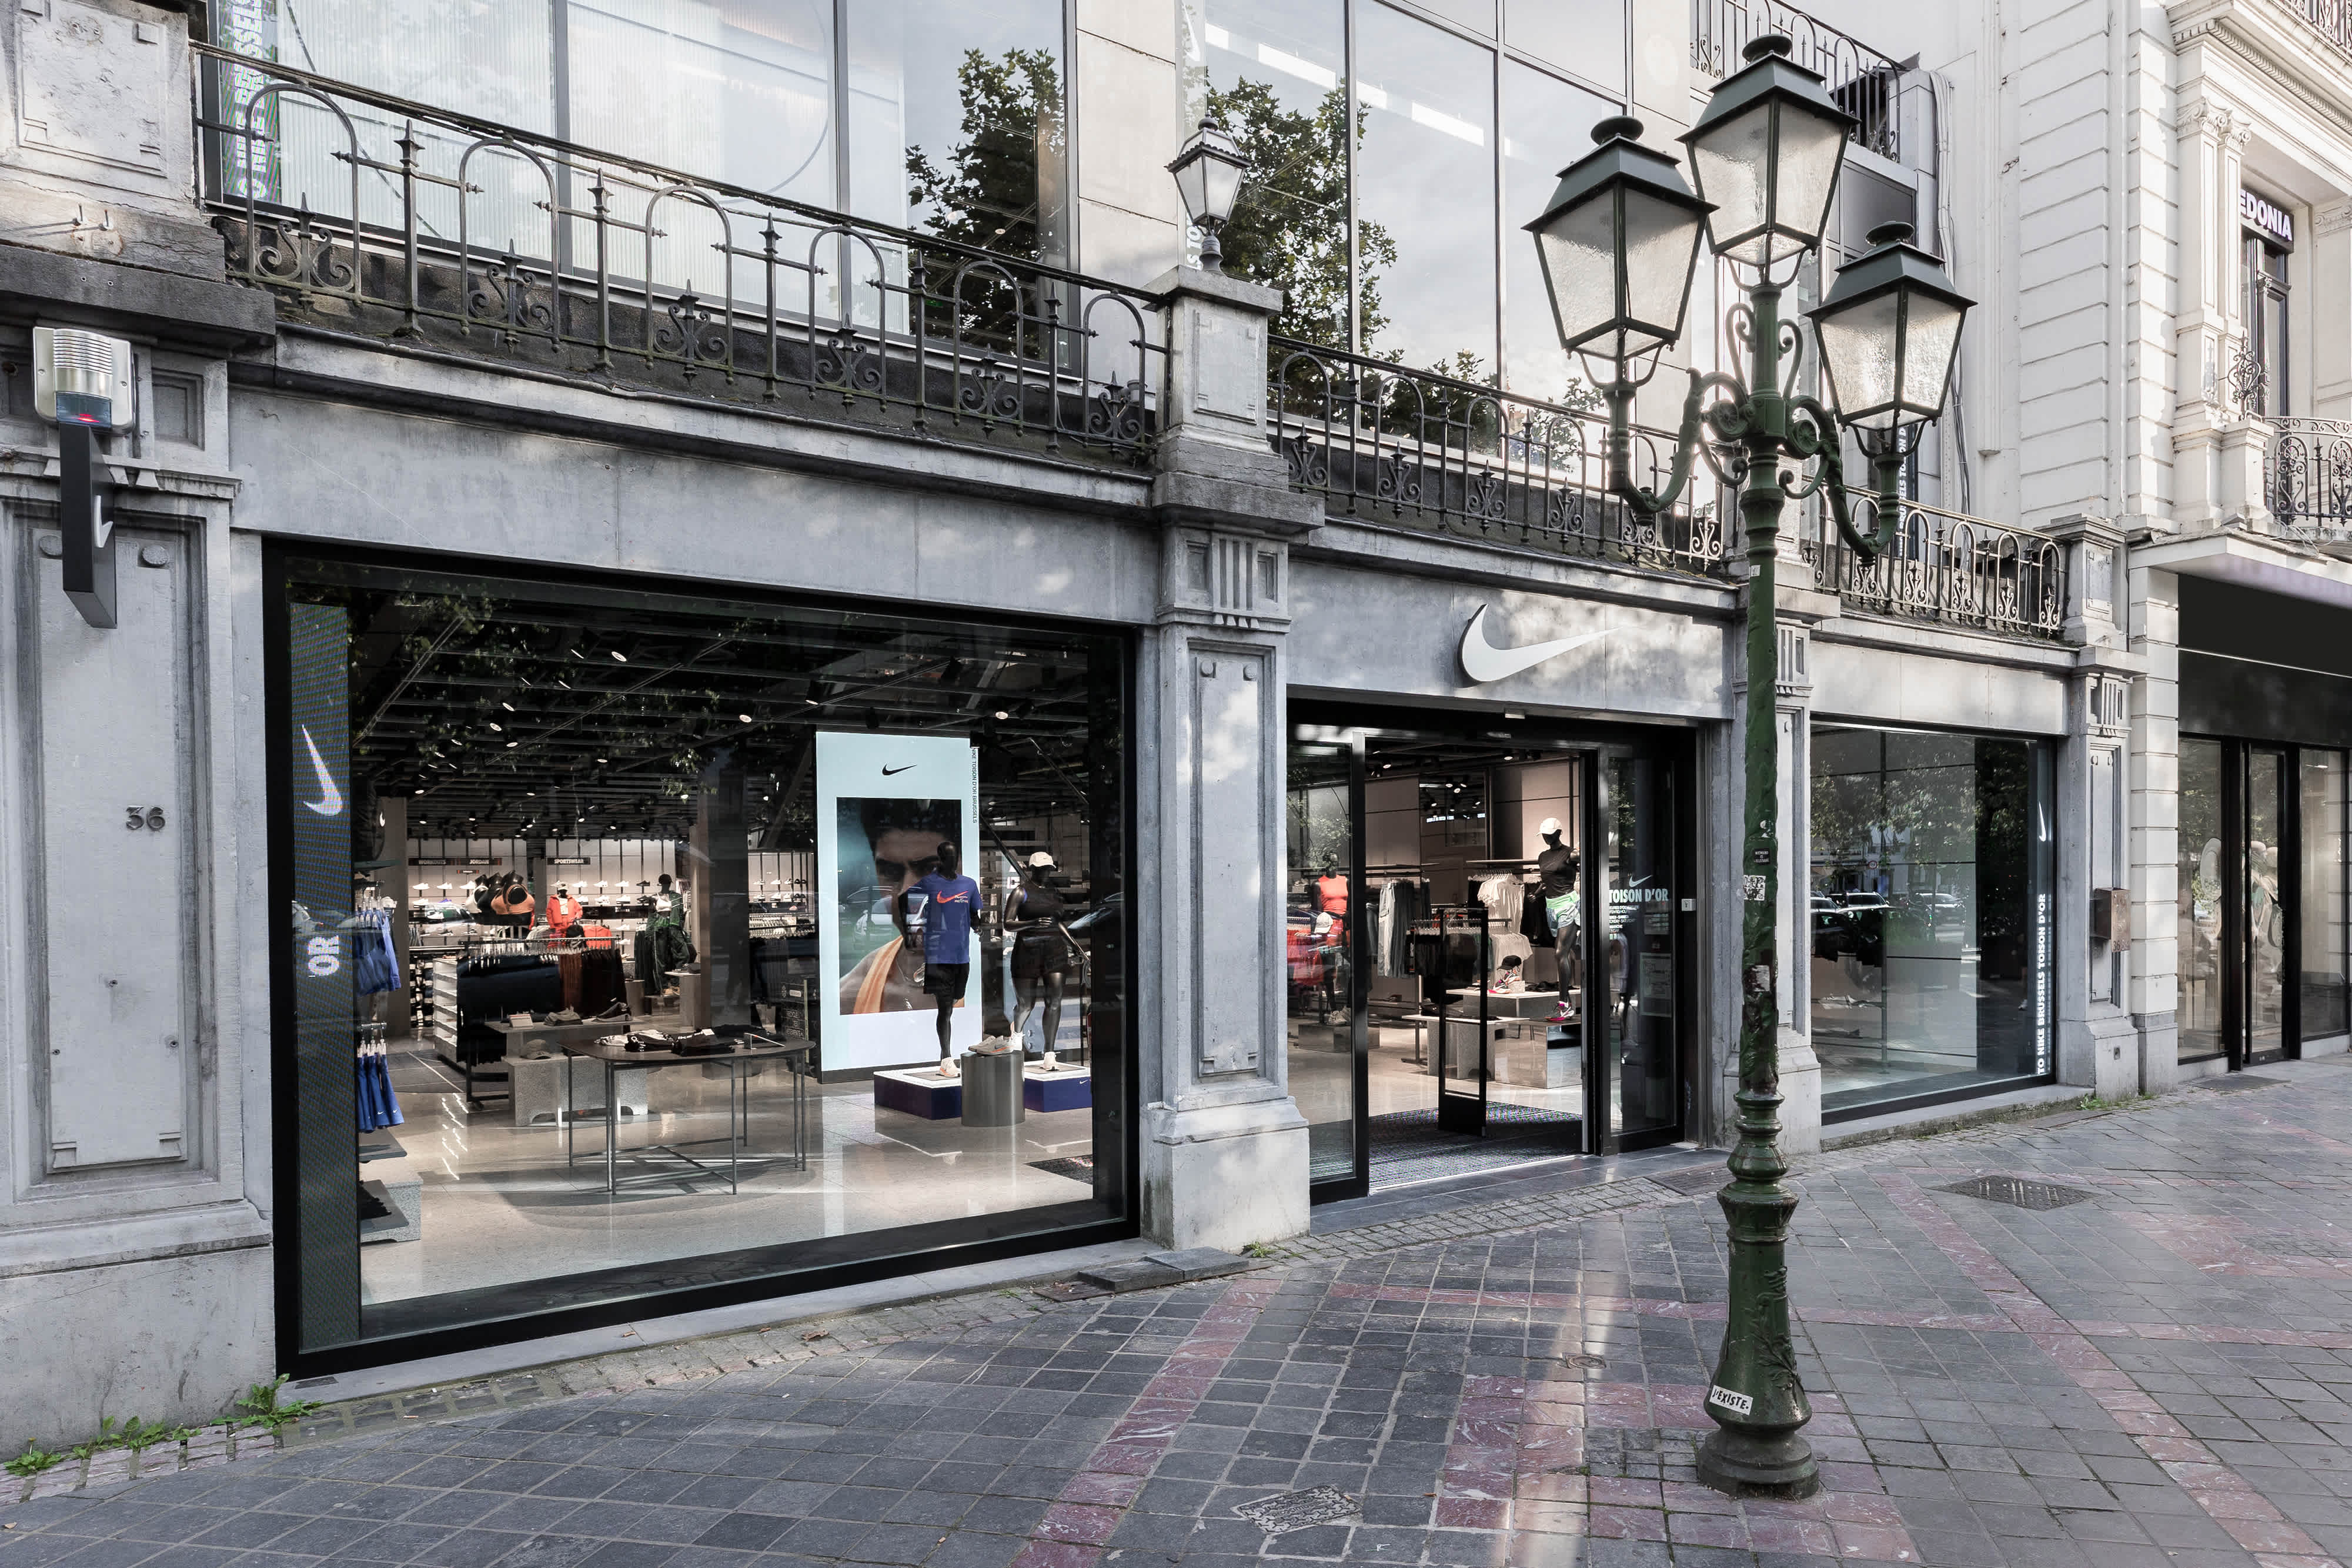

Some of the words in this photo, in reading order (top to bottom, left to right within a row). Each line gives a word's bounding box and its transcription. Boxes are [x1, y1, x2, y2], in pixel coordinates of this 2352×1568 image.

[126, 805, 165, 831] 36
[1609, 888, 1642, 904] TOISON
[1645, 888, 1669, 902] D'OR
[2038, 893, 2046, 924] D'OR
[2037, 927, 2046, 969] TOISON
[2037, 971, 2046, 1026] BRUSSELS
[2037, 1058, 2045, 1075] TO
